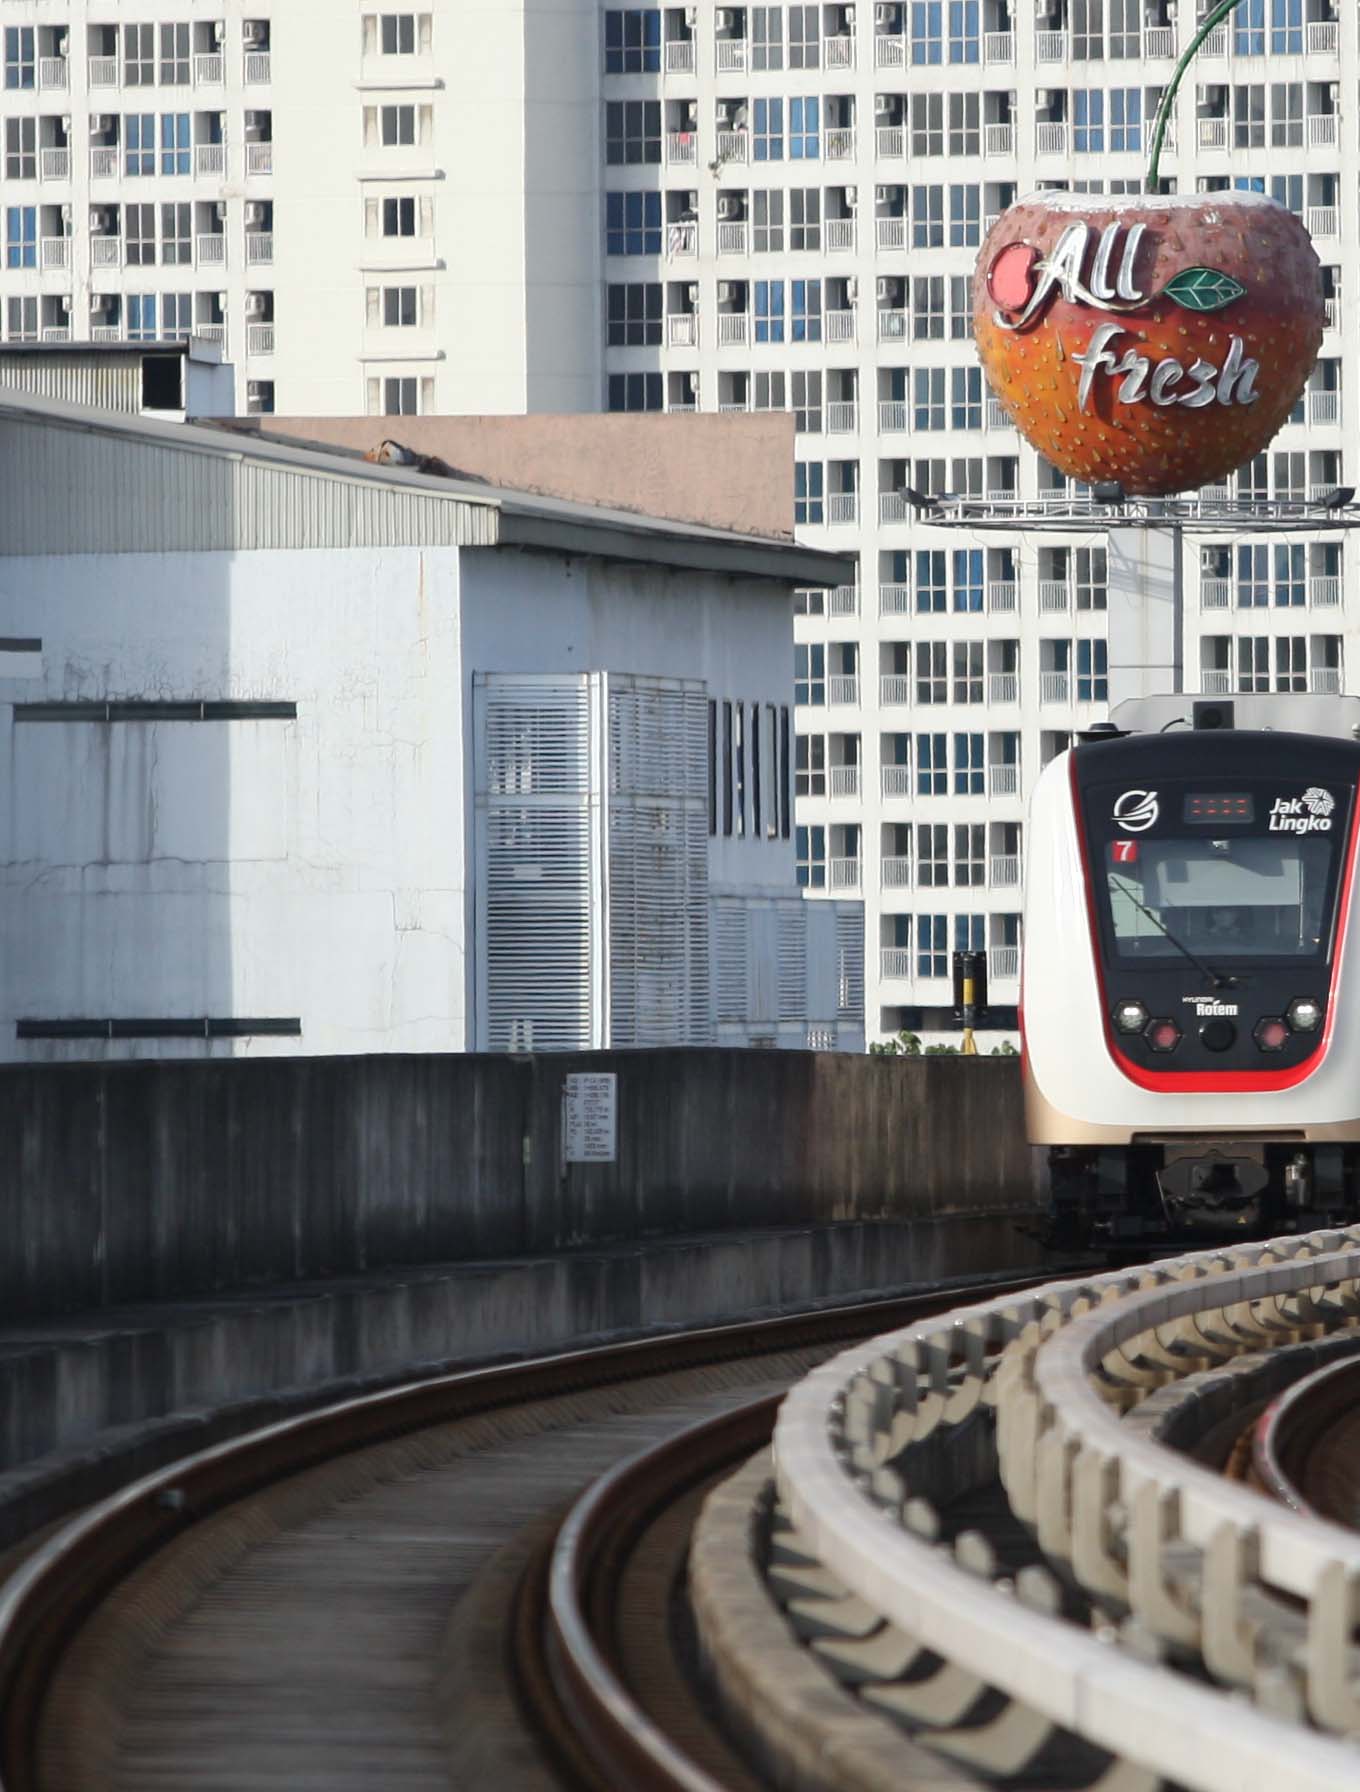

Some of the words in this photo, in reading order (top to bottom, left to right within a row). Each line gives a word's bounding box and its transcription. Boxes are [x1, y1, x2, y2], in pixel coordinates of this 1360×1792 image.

[992, 220, 1151, 329] All
[1269, 798, 1303, 814] Jak
[1269, 815, 1332, 835] Lingko
[1116, 841, 1132, 861] 7
[1196, 1000, 1238, 1016] Rotem
